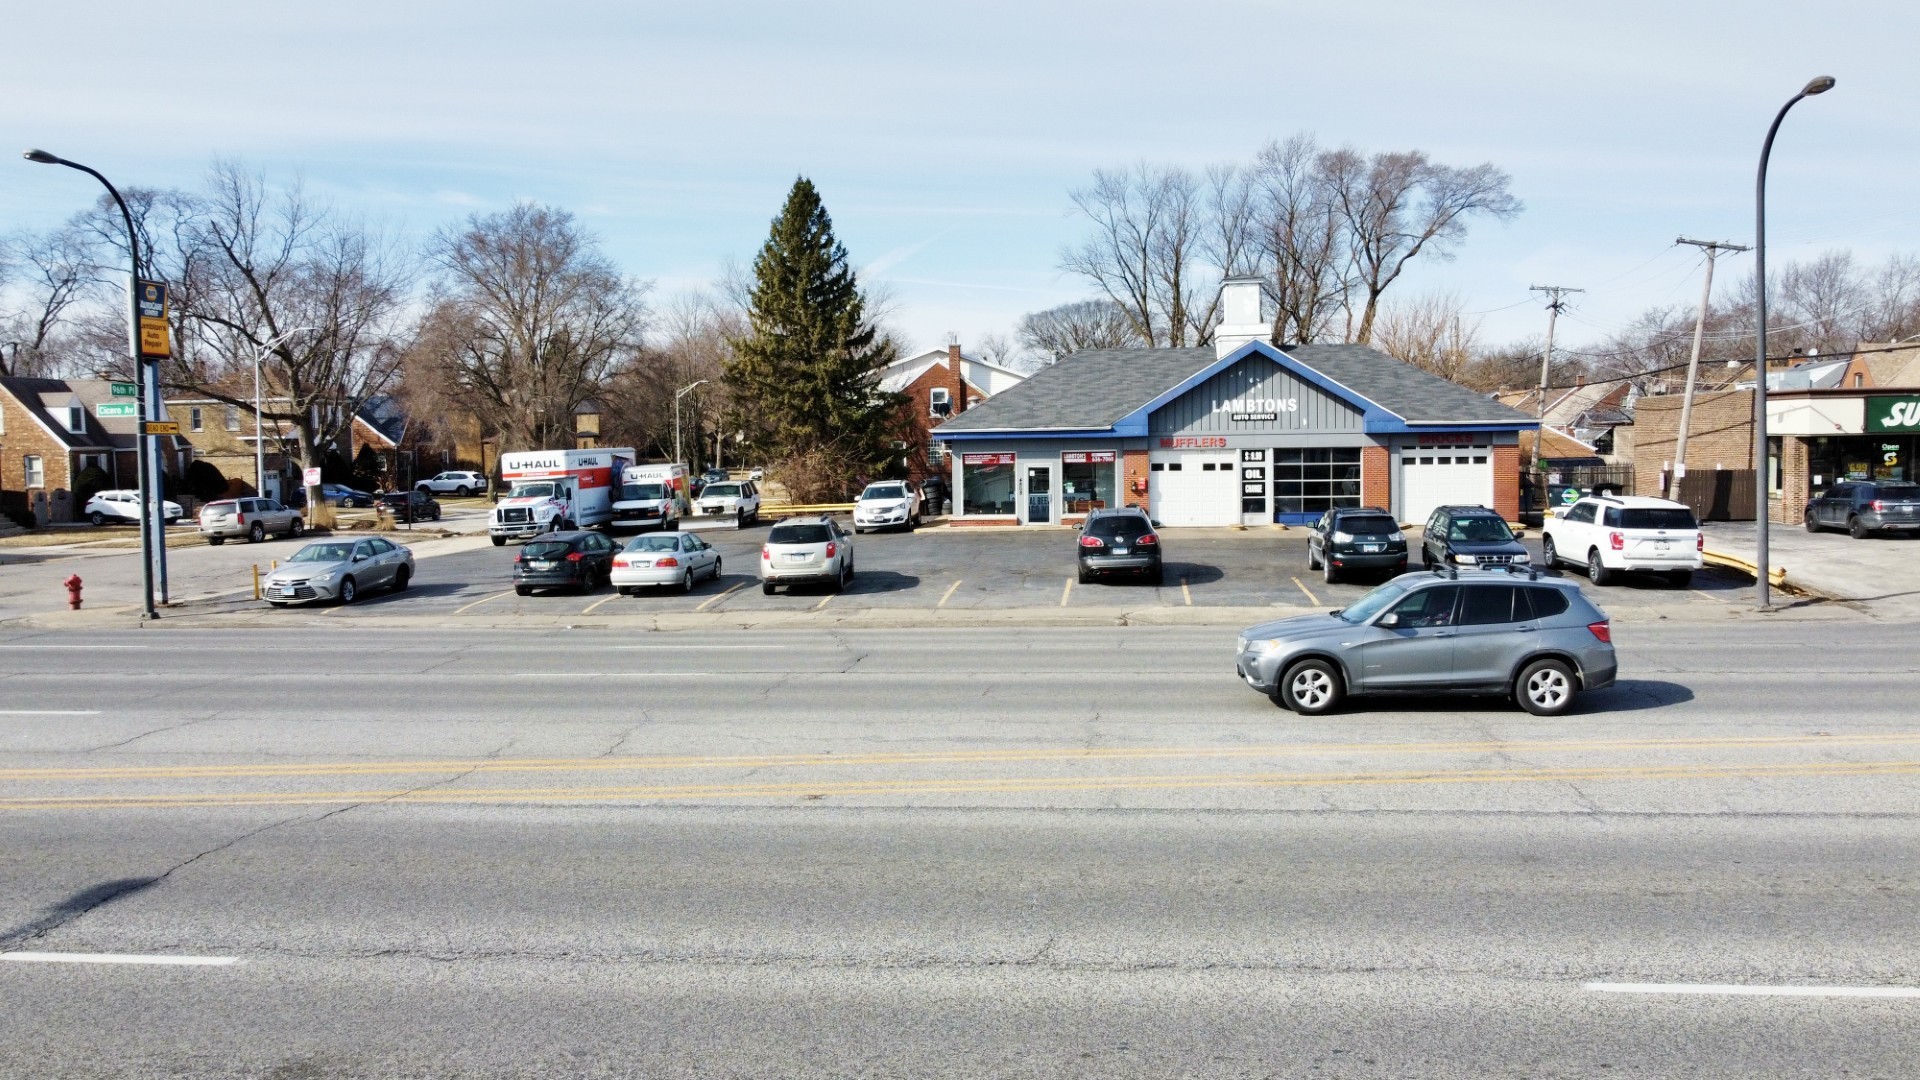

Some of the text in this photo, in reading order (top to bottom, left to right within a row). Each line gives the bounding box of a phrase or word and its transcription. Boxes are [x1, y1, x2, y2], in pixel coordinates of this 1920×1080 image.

[147, 331, 160, 339] Auto
[144, 339, 162, 348] Repair
[112, 385, 127, 394] 96th
[99, 406, 134, 415] Cicero Av
[1212, 399, 1298, 413] LAMBTONS
[1881, 402, 1920, 428] SU
[1160, 437, 1226, 448] MUFFLERS
[1245, 469, 1262, 479] OIL
